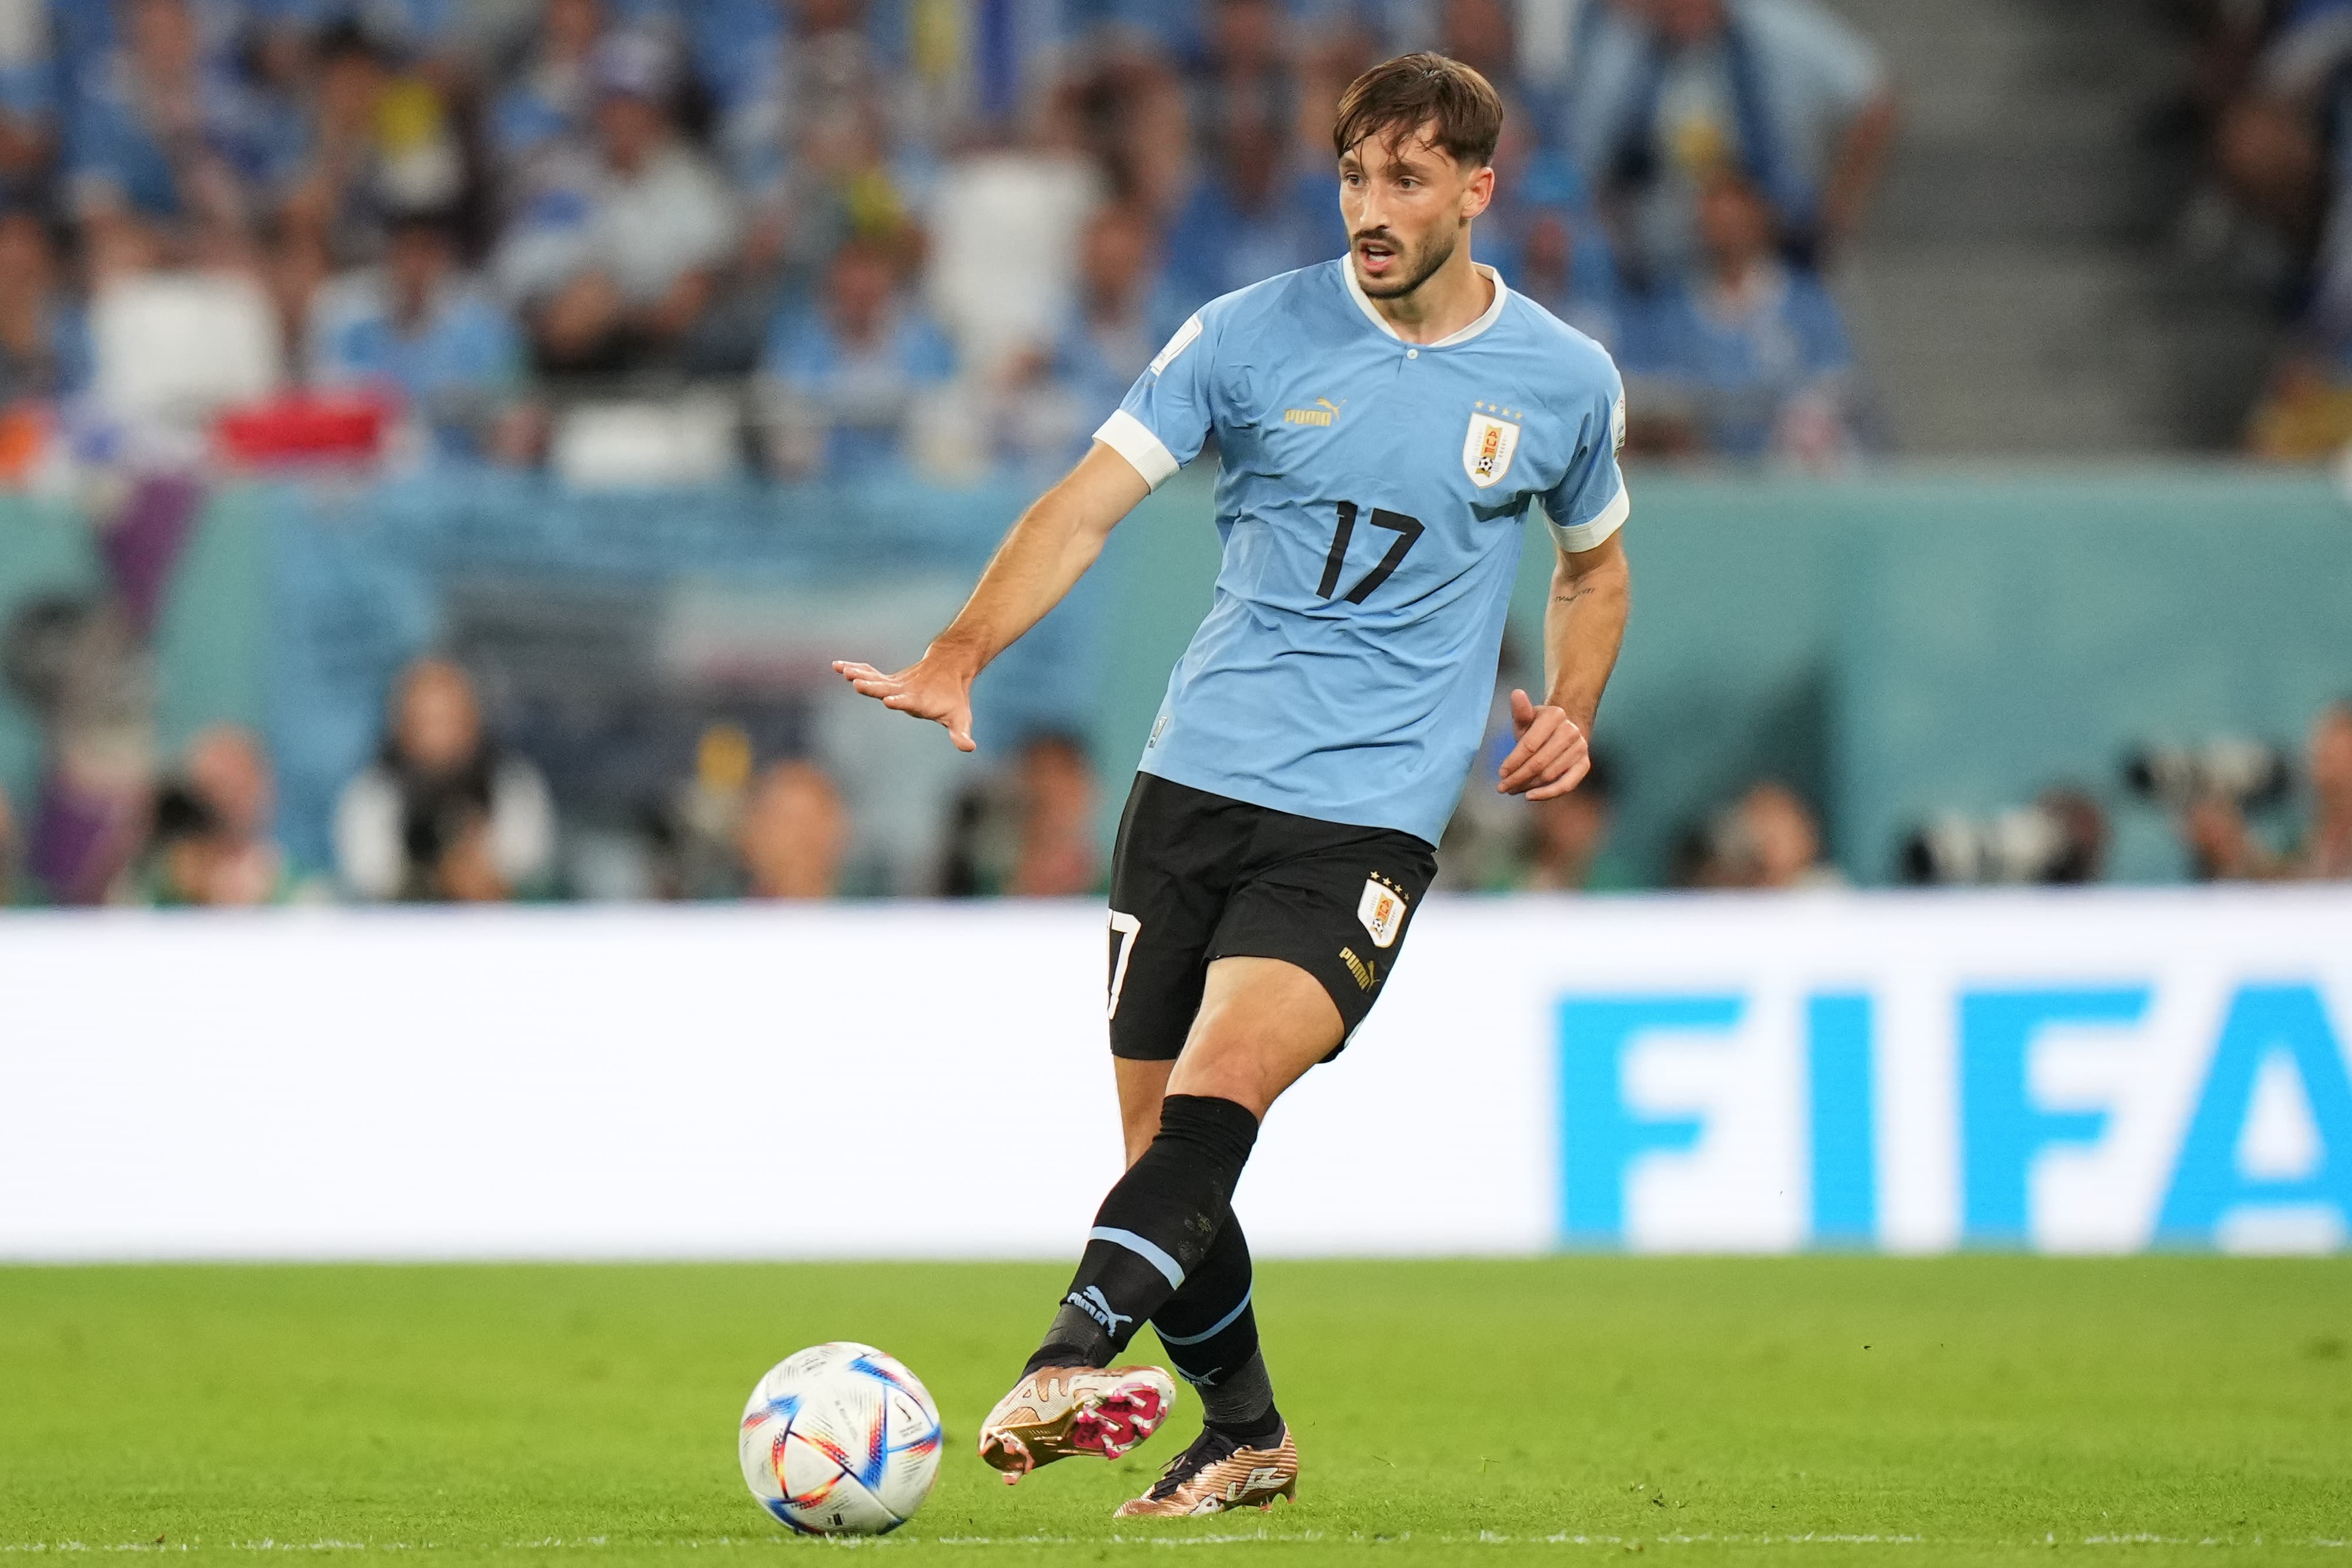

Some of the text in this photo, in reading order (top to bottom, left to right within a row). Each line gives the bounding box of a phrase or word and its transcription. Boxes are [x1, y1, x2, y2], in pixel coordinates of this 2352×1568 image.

[1284, 409, 1331, 426] PUMA
[1316, 501, 1425, 605] 17
[1107, 908, 1142, 1019] 7
[1339, 947, 1371, 990] PUMA
[1555, 984, 2352, 1249] FIFA
[1067, 1292, 1108, 1326] PUMA
